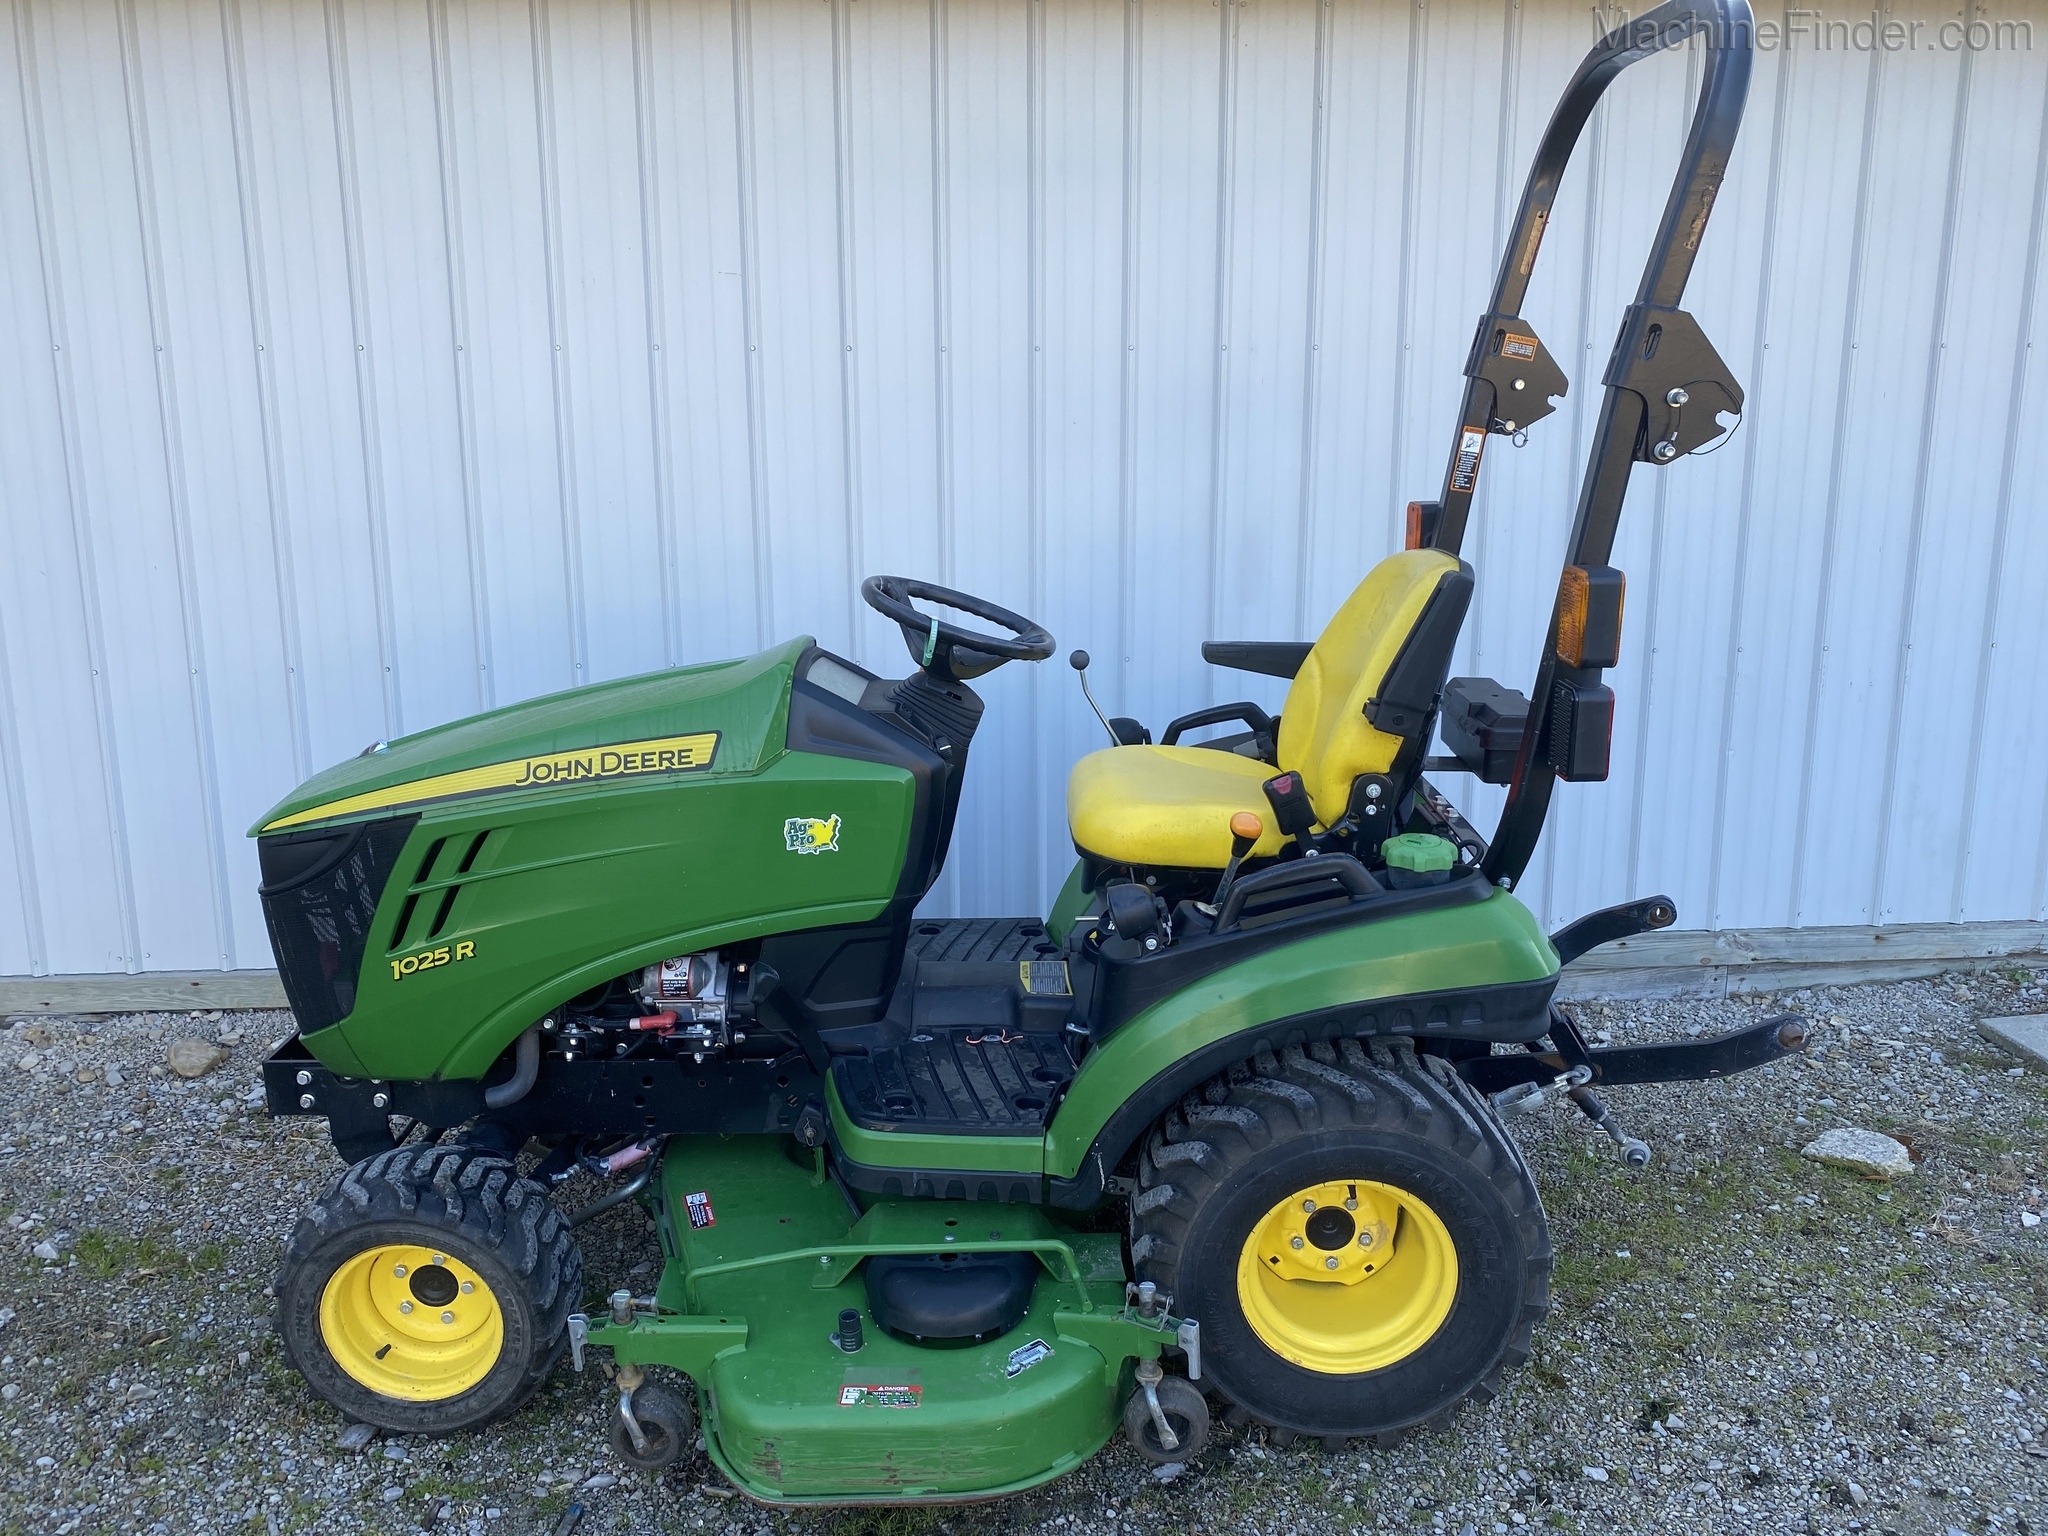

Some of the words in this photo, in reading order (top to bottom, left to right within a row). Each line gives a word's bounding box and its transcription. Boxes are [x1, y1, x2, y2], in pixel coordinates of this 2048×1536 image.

[515, 757, 593, 784] JOHN
[600, 748, 694, 773] DEERE
[788, 821, 813, 836] Ag-
[789, 834, 815, 847] Pro
[390, 946, 451, 980] 1025
[456, 940, 476, 961] R
